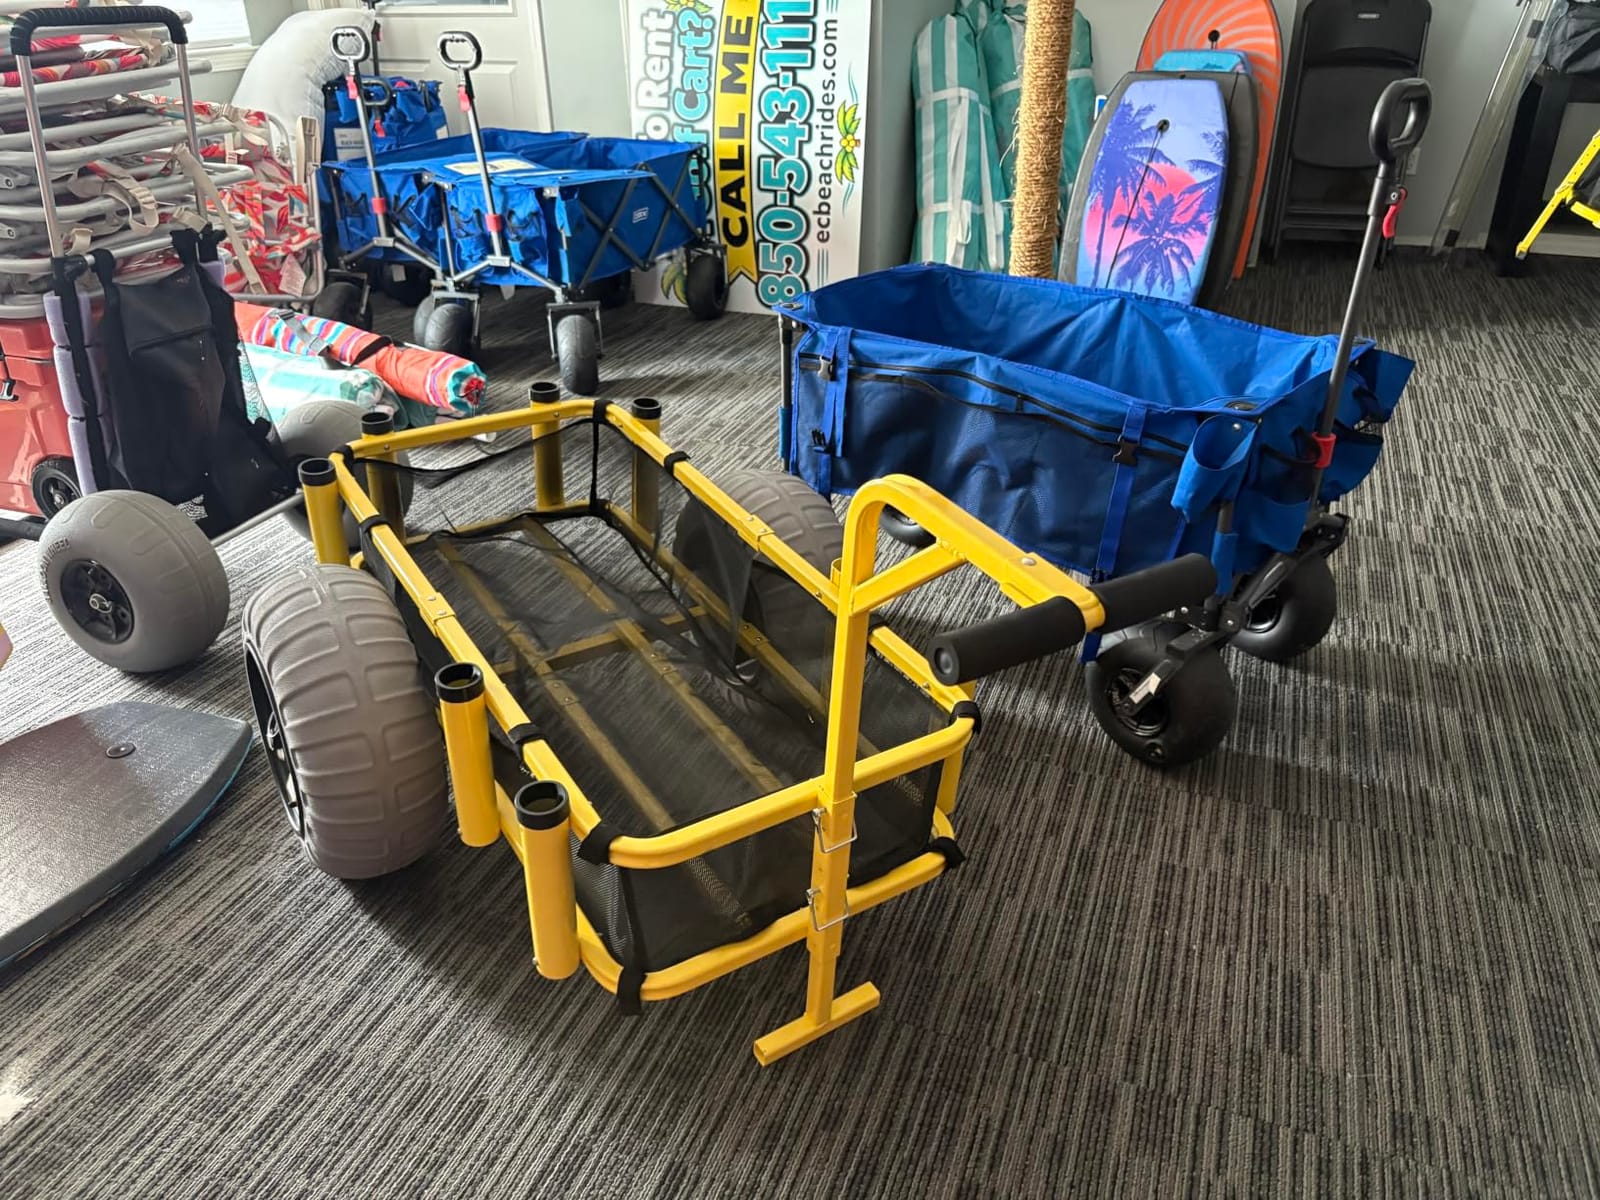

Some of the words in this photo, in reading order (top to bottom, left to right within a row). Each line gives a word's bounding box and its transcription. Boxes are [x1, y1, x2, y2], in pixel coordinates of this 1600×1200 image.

[637, 8, 674, 110] Rent
[673, 7, 715, 122] Cart?
[720, 15, 754, 95] ME
[637, 113, 671, 141] o
[718, 112, 749, 248] CALL
[813, 18, 838, 243] ecbeachrides.com
